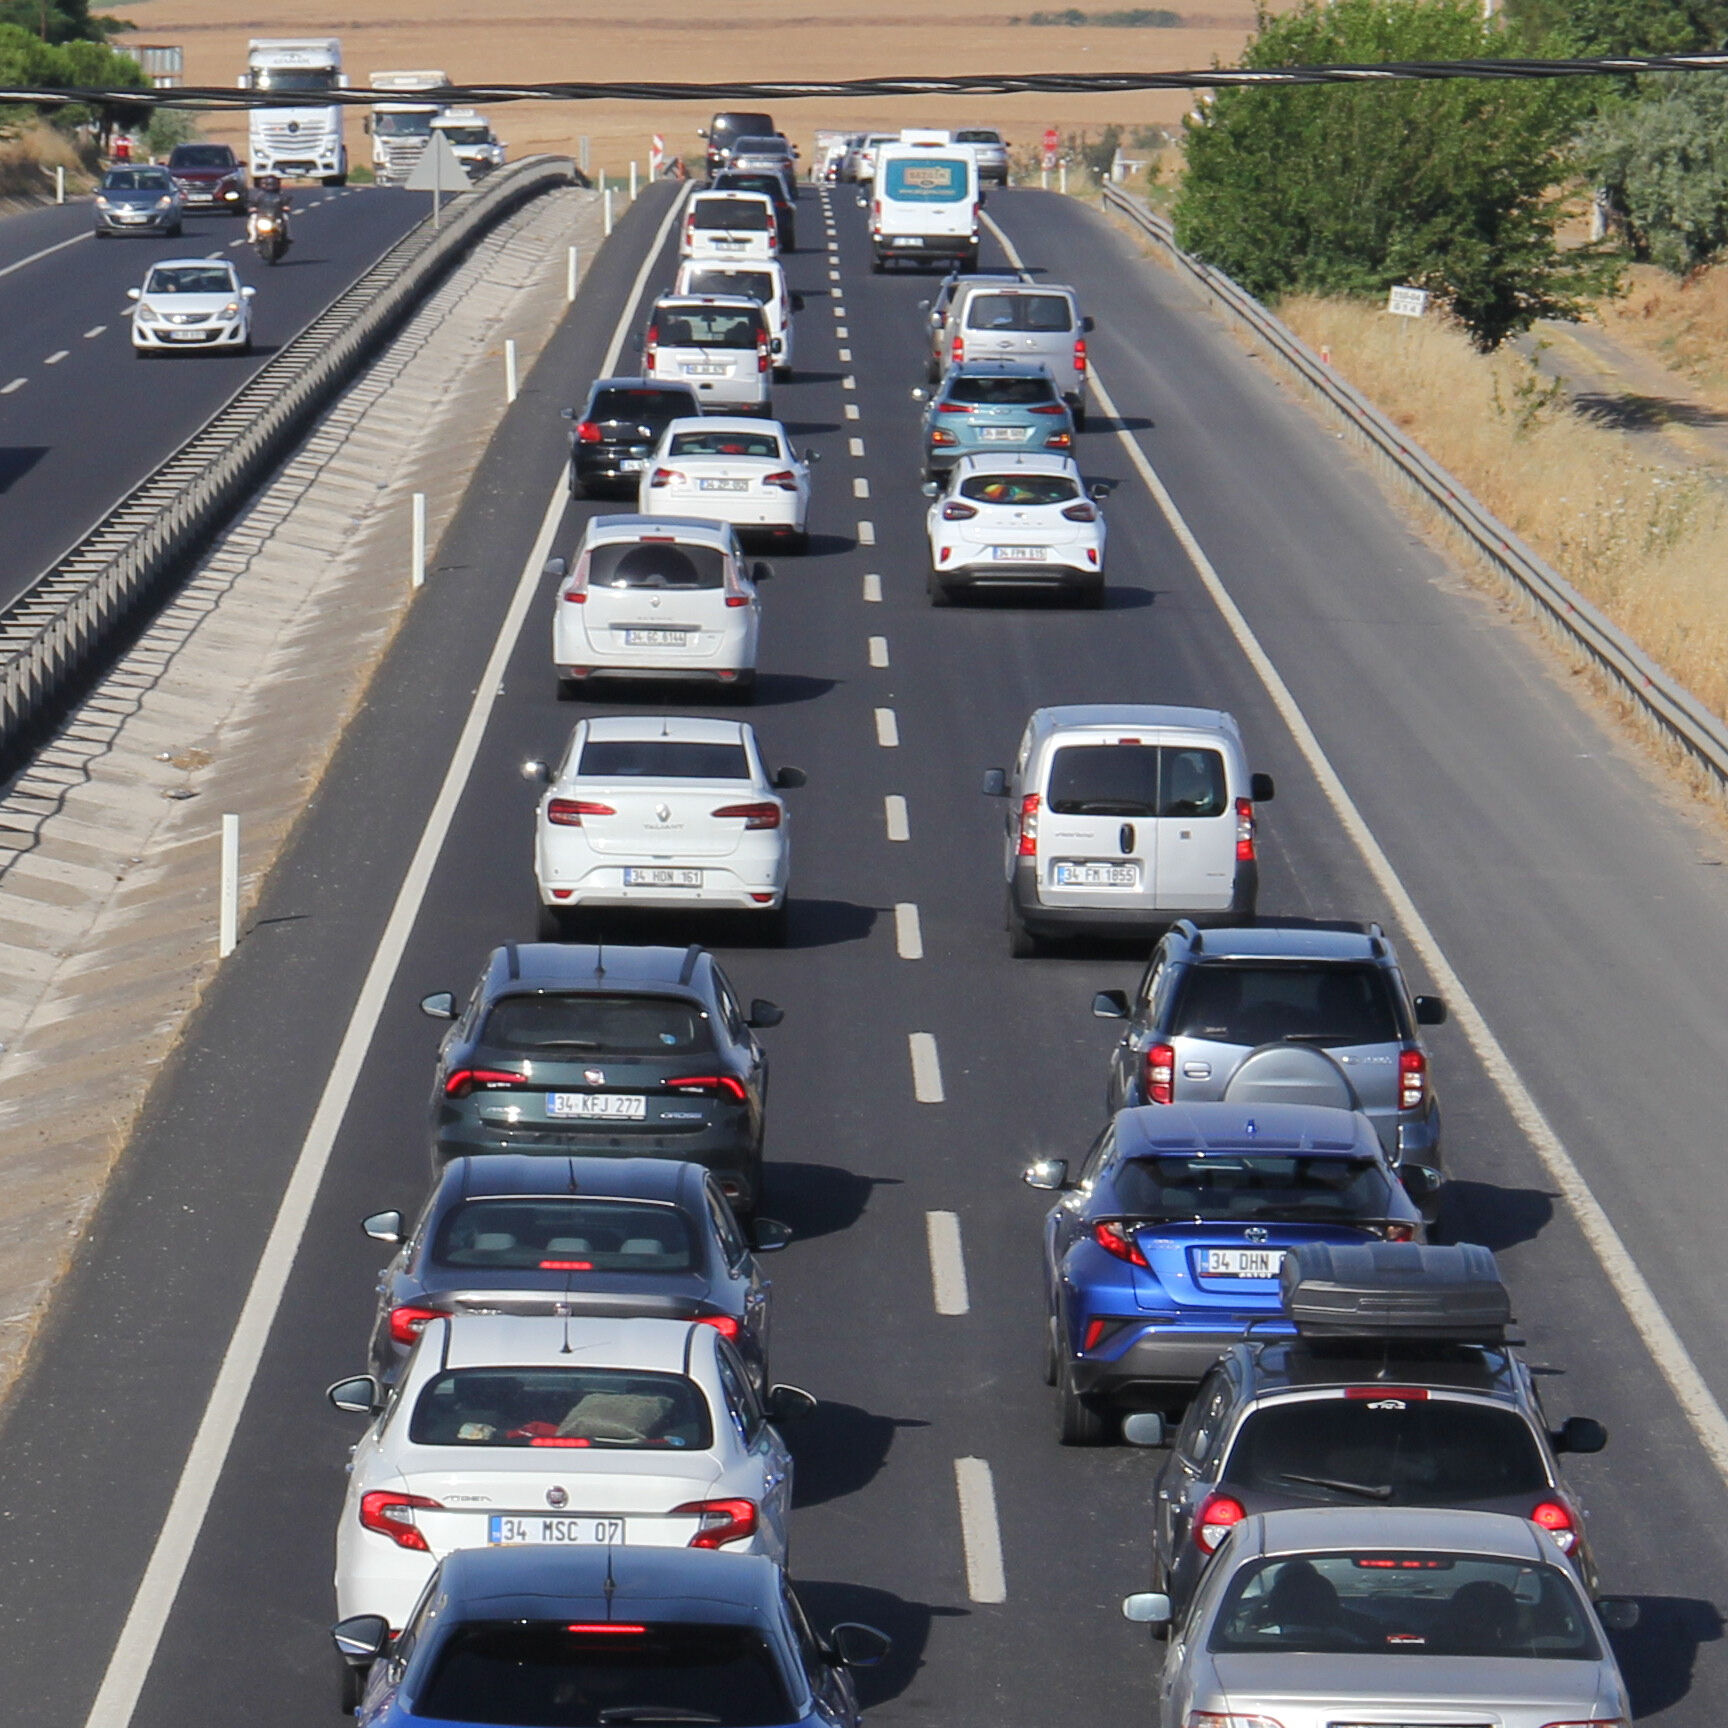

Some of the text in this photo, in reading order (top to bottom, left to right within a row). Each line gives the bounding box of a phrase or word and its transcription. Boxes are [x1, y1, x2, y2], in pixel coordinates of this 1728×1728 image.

[633, 870, 699, 883] 34 HDN 161
[1064, 868, 1134, 882] 34 FM 1855
[556, 1095, 642, 1113] 34 KFJ 277
[1210, 1253, 1270, 1271] 34 DHN
[503, 1520, 527, 1541] 34
[542, 1520, 579, 1542] MSC
[594, 1522, 619, 1542] 07
